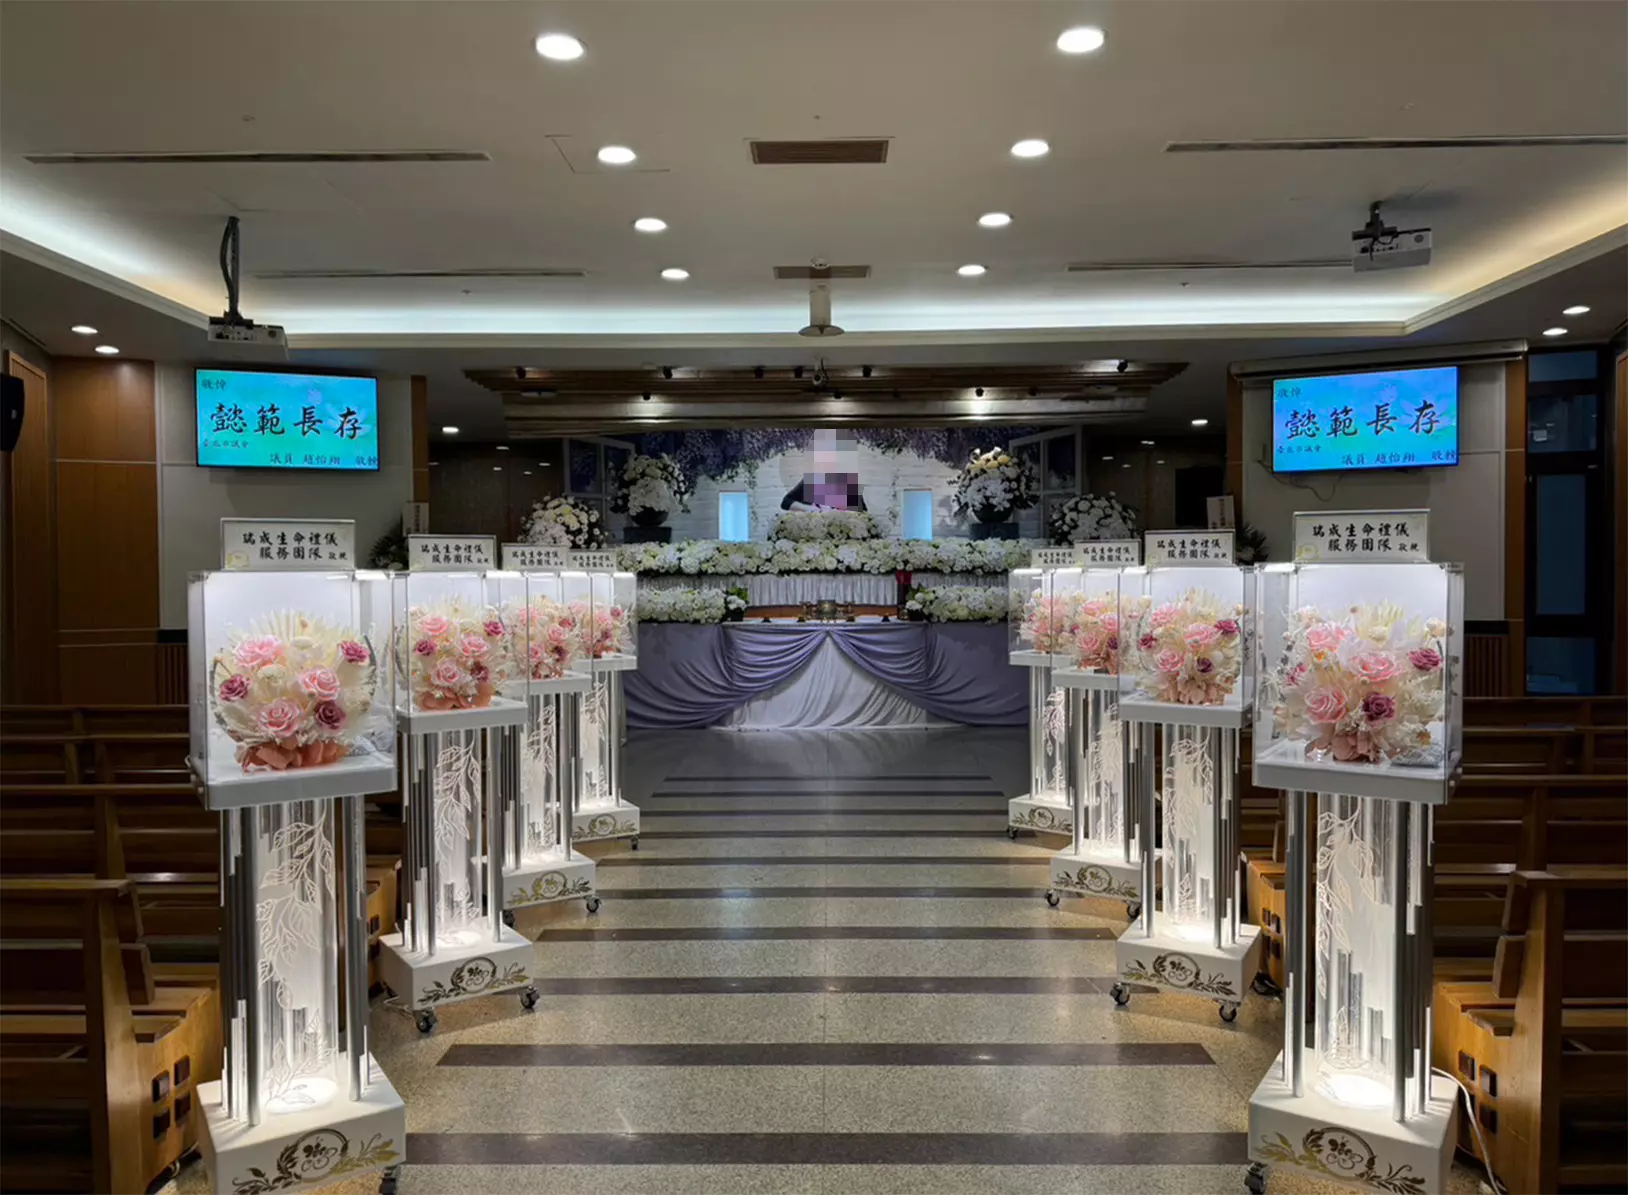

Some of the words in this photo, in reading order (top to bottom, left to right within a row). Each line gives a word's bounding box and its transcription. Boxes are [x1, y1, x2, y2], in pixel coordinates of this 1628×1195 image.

[210, 403, 362, 440] 懿範長存
[1285, 400, 1441, 440] 懿範長存
[1313, 522, 1410, 537] 瑞成生命禮儀
[243, 531, 338, 546] 瑞成生命禮儀
[1328, 538, 1392, 552] 服務團隊
[259, 547, 323, 560] 服務團隊
